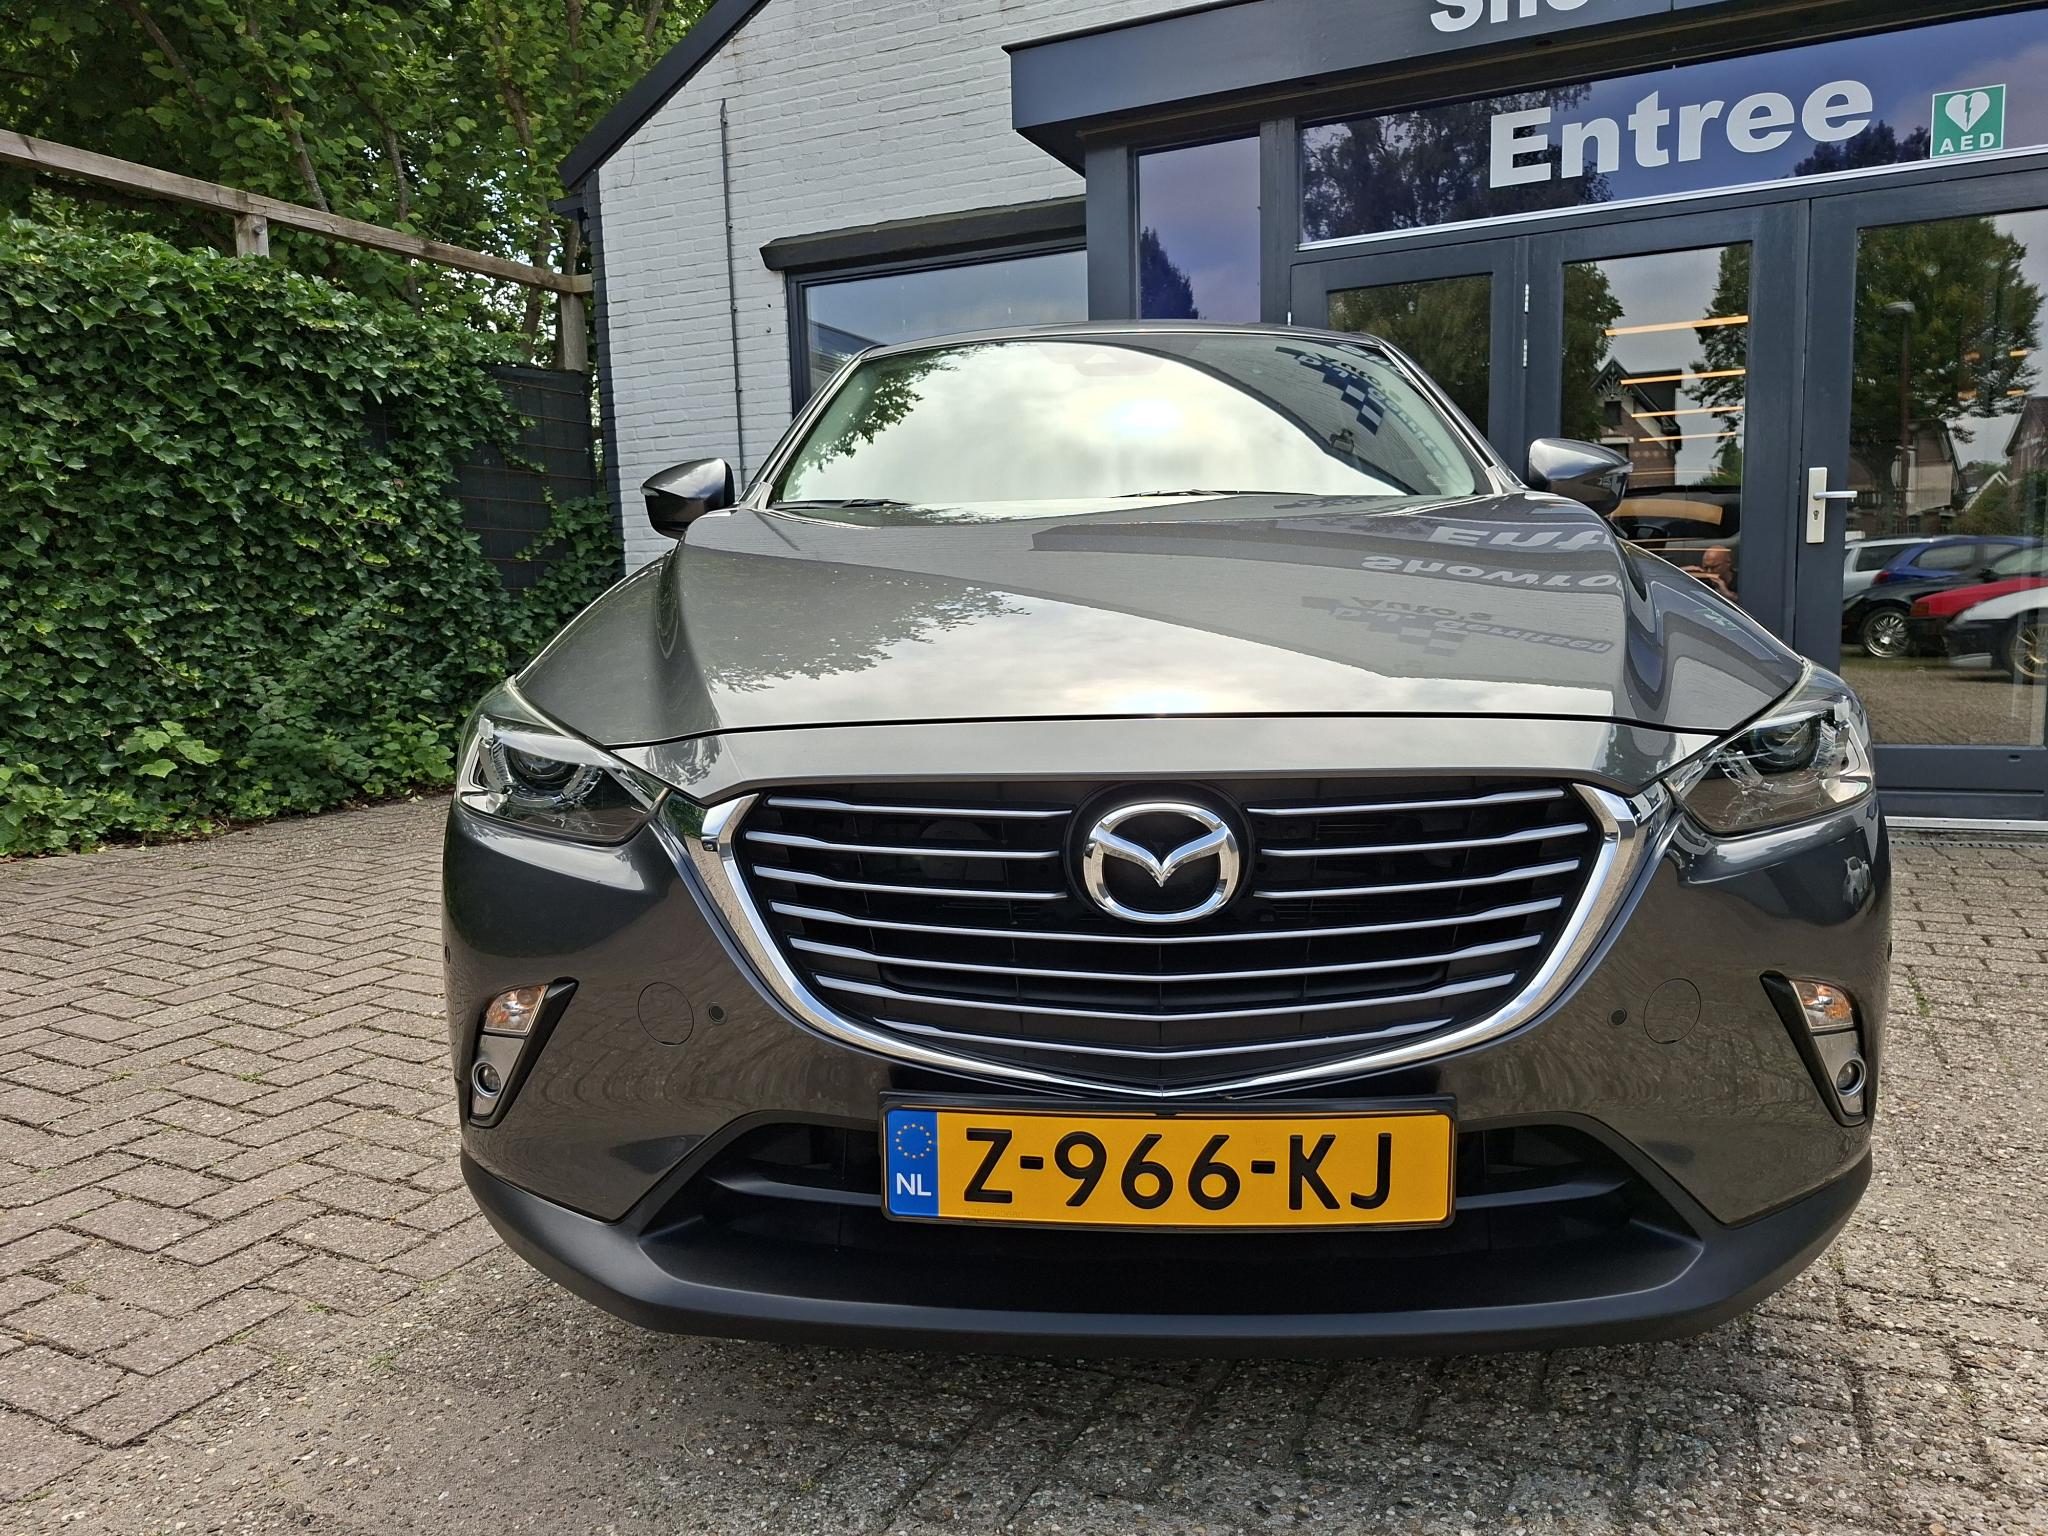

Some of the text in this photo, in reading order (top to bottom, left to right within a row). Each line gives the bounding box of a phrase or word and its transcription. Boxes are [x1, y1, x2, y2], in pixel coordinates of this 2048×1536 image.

[1490, 79, 1873, 188] Entree
[1938, 132, 1995, 154] AED
[896, 1173, 932, 1196] NL
[964, 1128, 1392, 1211] Z-966-KJ
